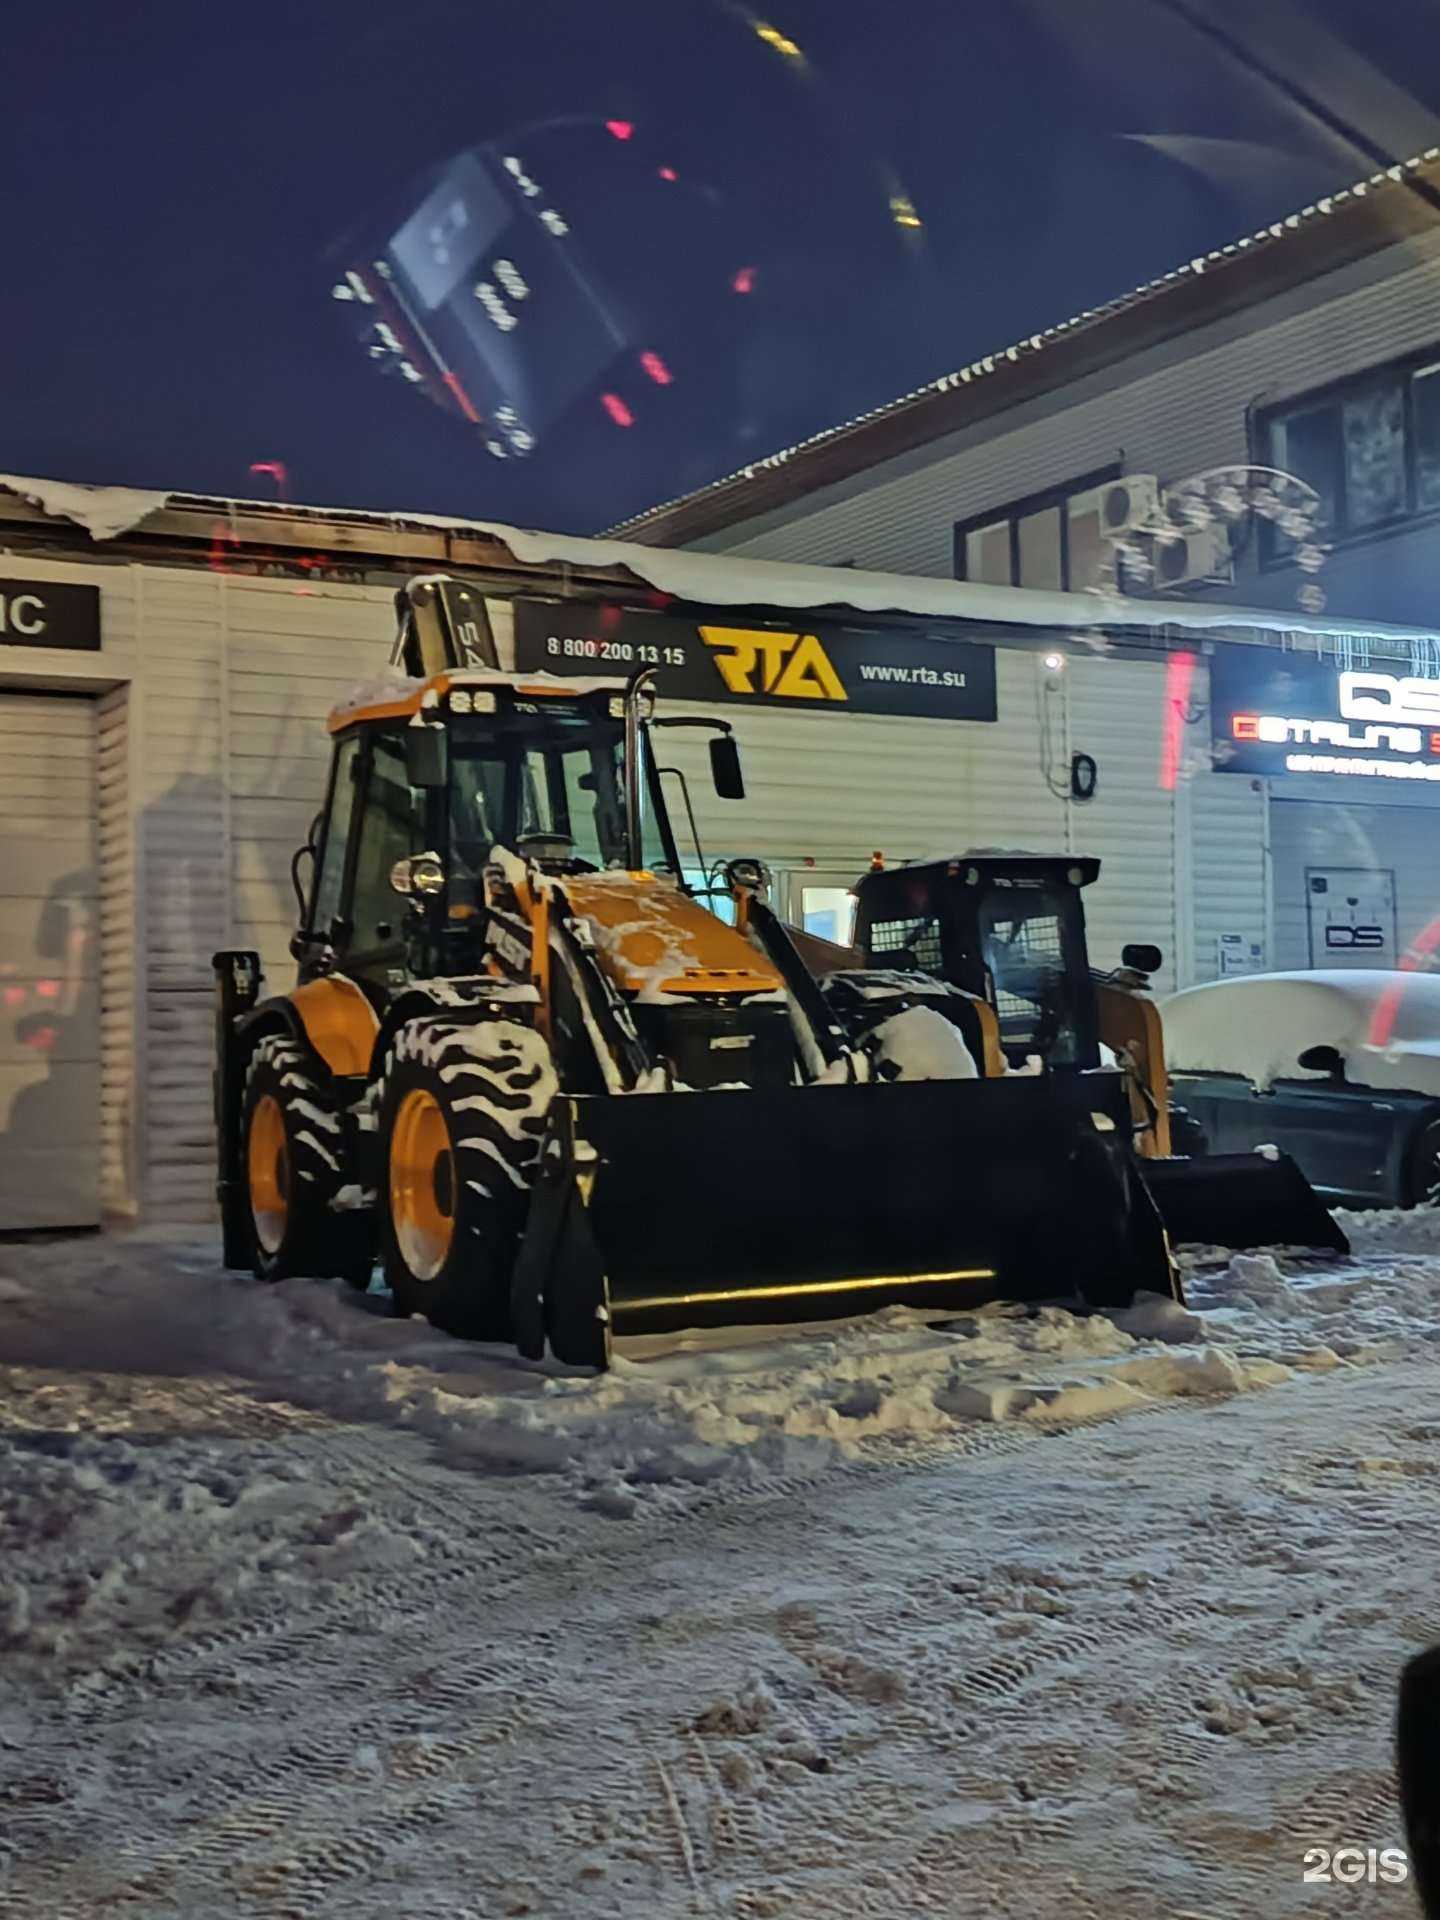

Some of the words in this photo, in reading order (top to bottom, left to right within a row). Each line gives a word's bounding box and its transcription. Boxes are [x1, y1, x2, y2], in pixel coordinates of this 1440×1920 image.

[547, 637, 560, 655] 8
[563, 639, 596, 658] 800
[599, 642, 633, 661] 200
[637, 645, 660, 663] 13
[663, 647, 686, 665] 15
[698, 626, 848, 700] RTA
[860, 664, 966, 687] www.rta.su
[1325, 925, 1384, 948] DS
